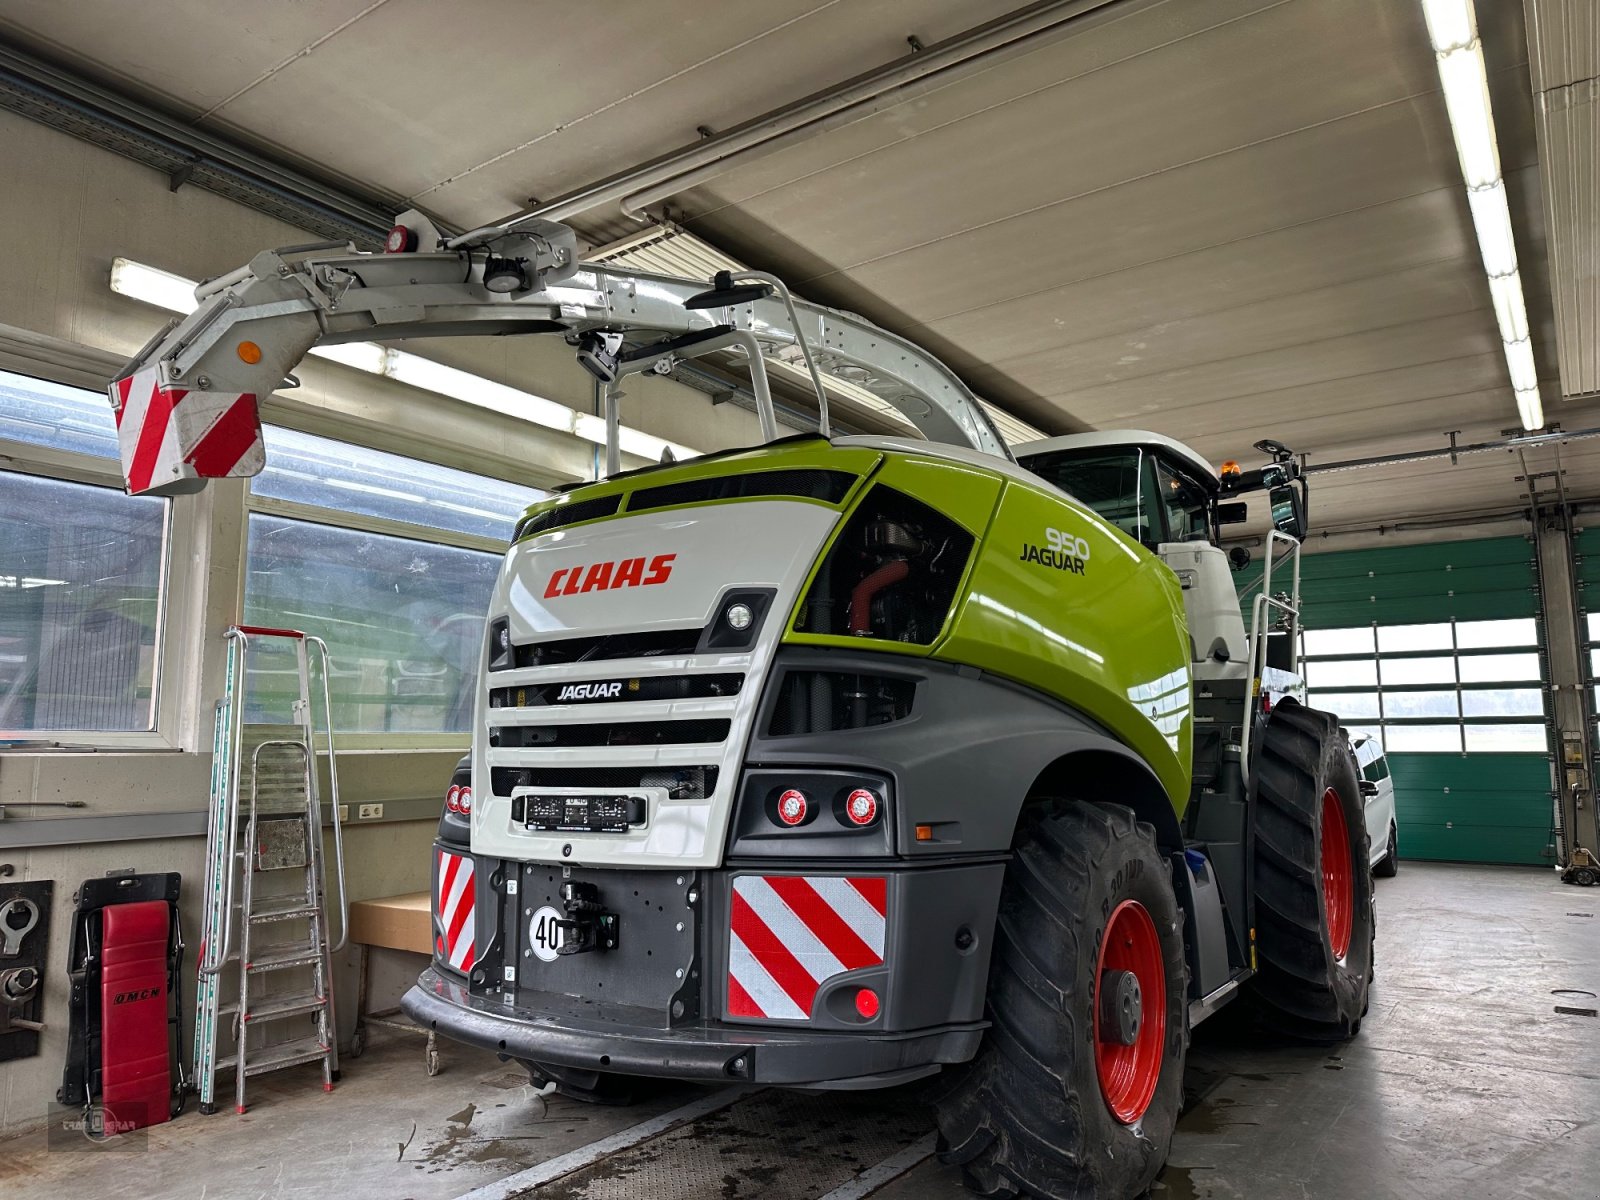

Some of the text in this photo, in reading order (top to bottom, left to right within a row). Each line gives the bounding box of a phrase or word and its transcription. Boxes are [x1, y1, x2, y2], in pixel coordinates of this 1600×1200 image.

[1020, 544, 1085, 576] JAGUAR
[1046, 528, 1090, 560] 950
[544, 553, 677, 598] CLAAS
[557, 683, 622, 700] JAGUAR
[535, 916, 559, 950] 40
[114, 987, 160, 1005] OMCN
